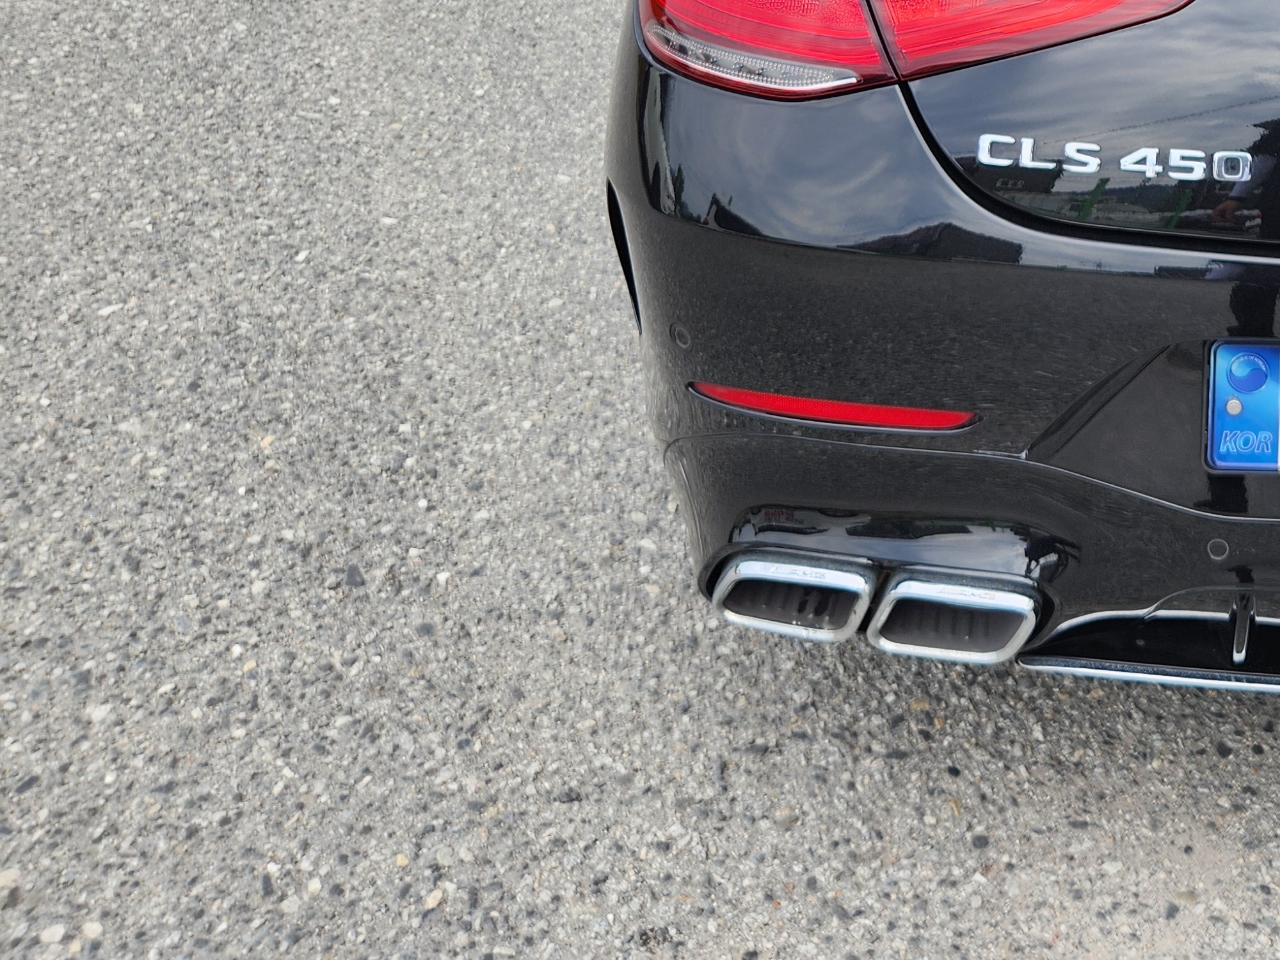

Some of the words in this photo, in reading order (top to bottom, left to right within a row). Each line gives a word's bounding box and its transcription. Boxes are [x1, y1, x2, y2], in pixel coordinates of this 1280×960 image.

[977, 132, 1102, 174] CLS
[1120, 146, 1253, 183] 450
[1219, 430, 1273, 454] KOR
